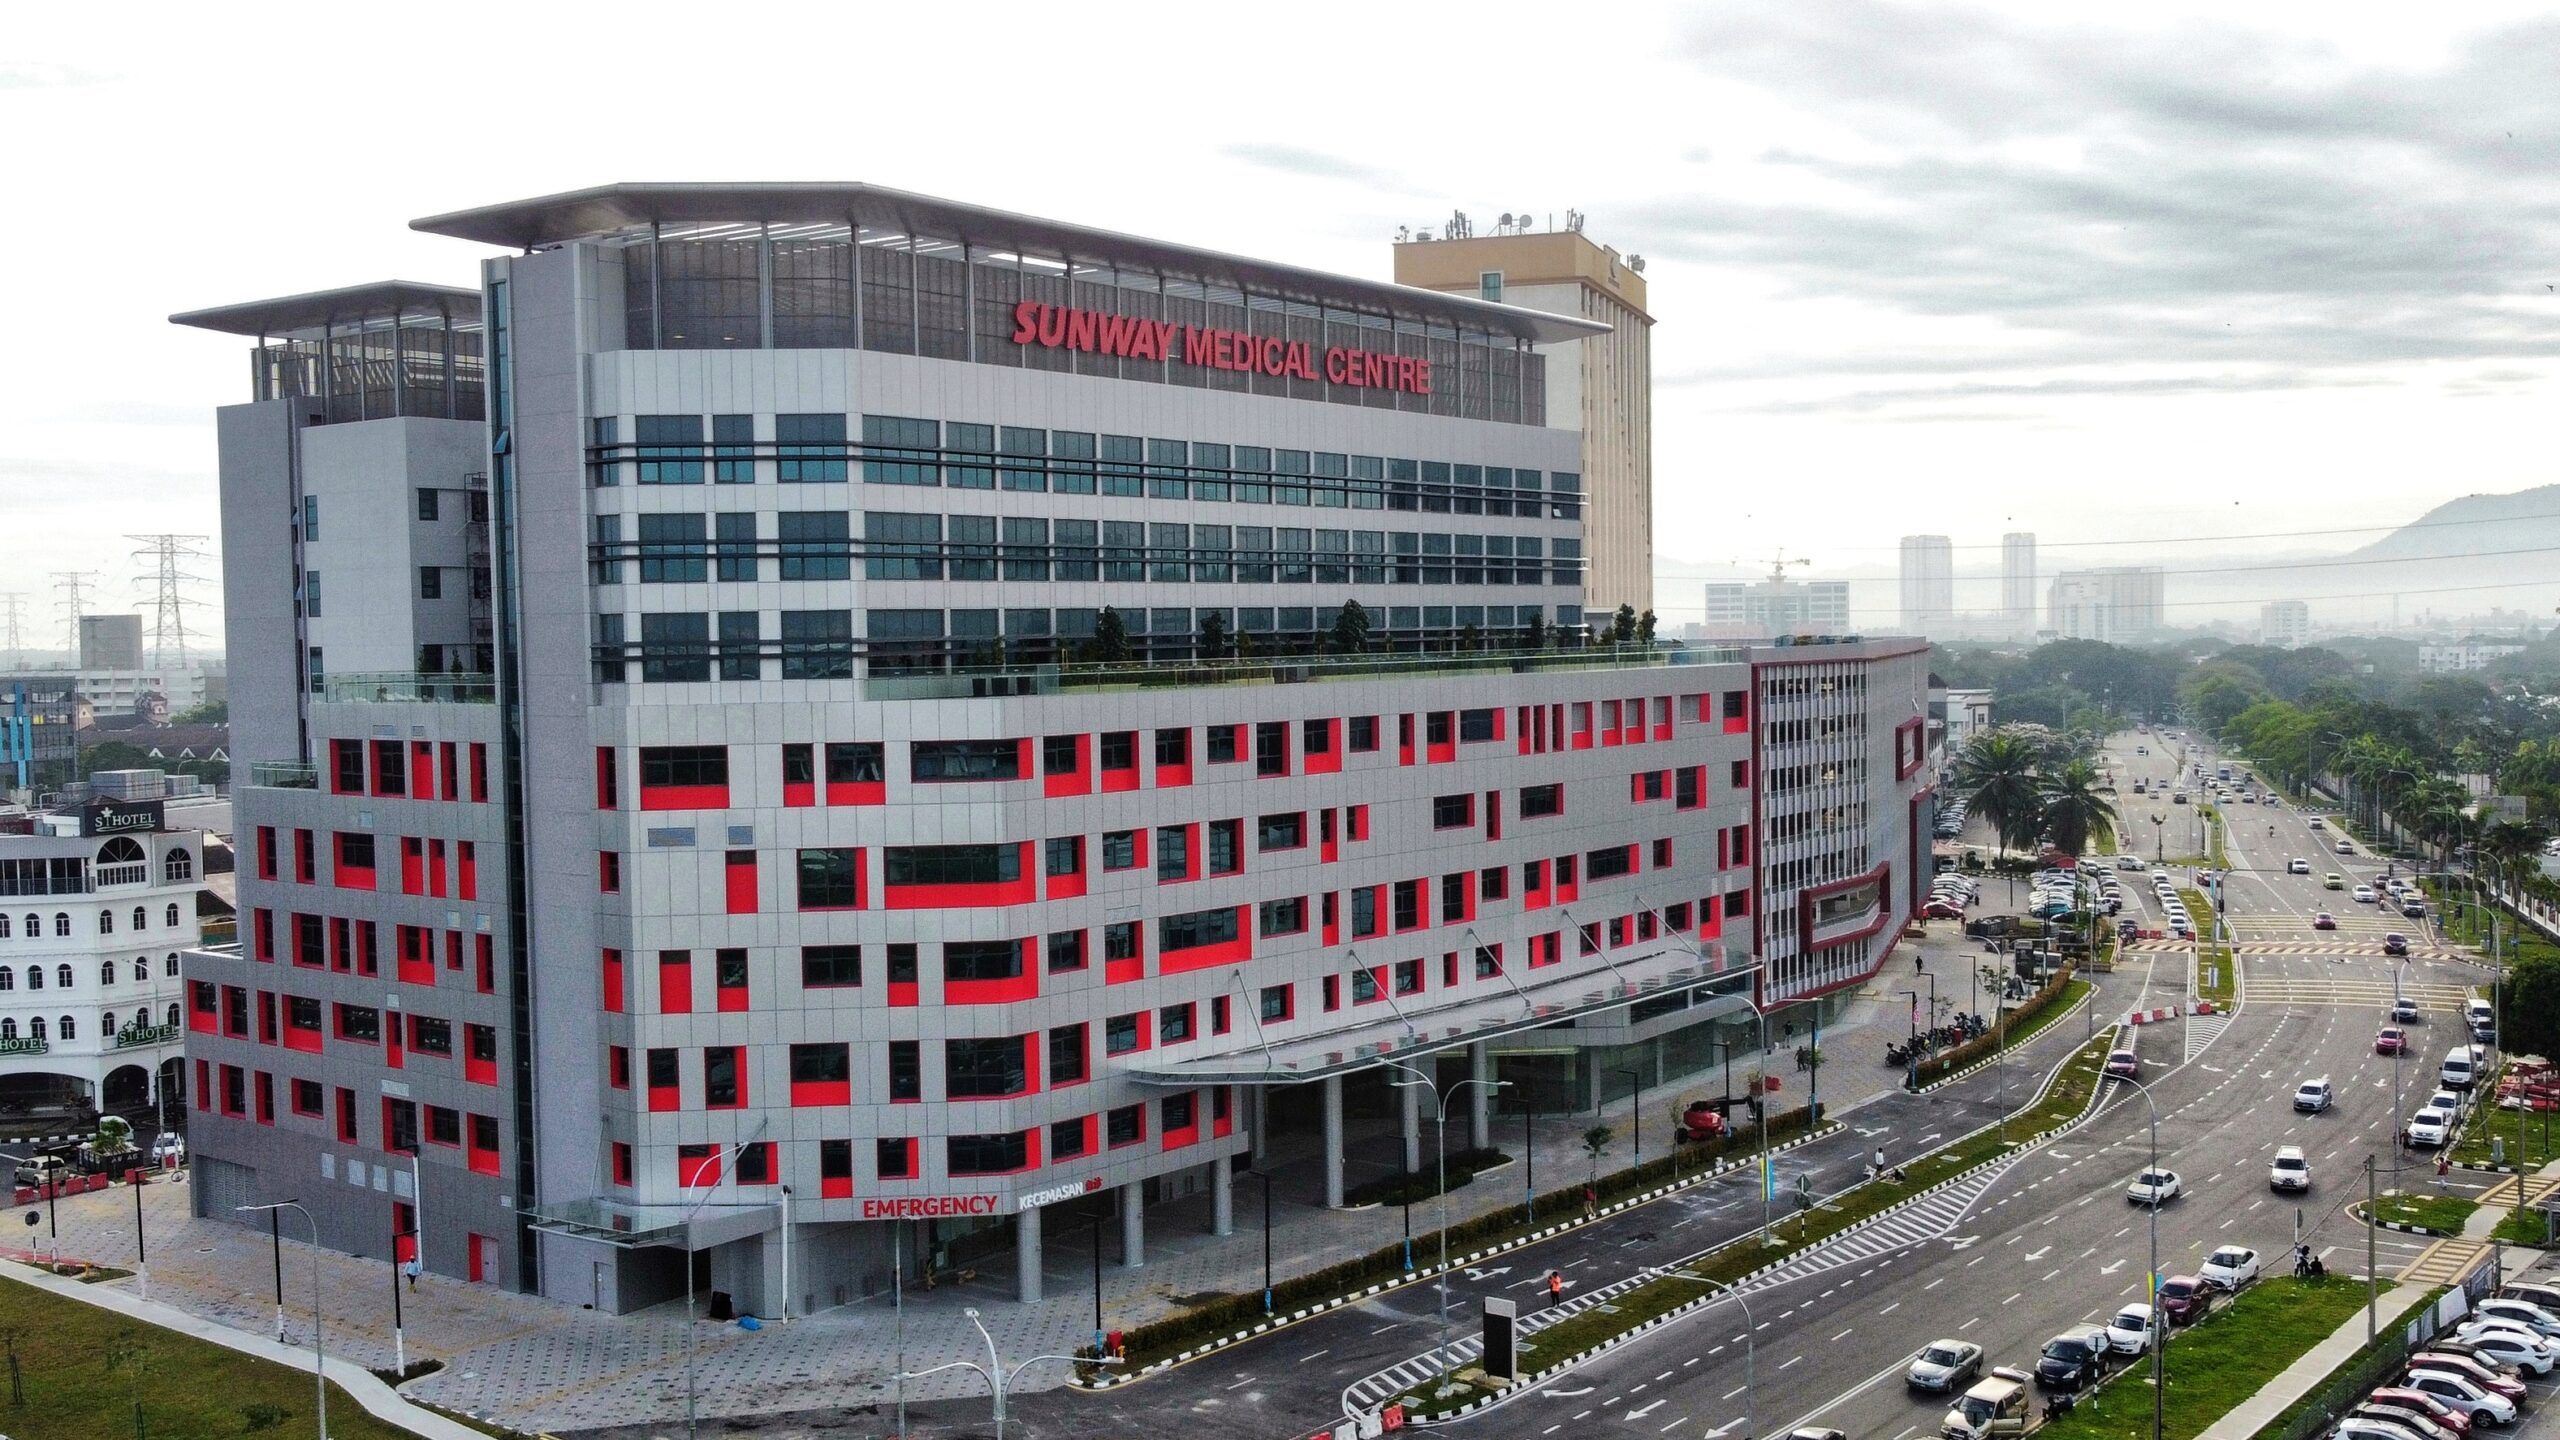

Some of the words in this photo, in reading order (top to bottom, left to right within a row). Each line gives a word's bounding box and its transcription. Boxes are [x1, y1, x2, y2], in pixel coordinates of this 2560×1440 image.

[1012, 300, 1178, 362] SUNWAY
[1185, 323, 1320, 381] MEDICAL
[1326, 346, 1433, 394] CENTRE
[0, 1038, 48, 1050] HOTEL
[863, 1195, 997, 1218] EMERGENCY
[1019, 1181, 1084, 1211] KECEMASAN
